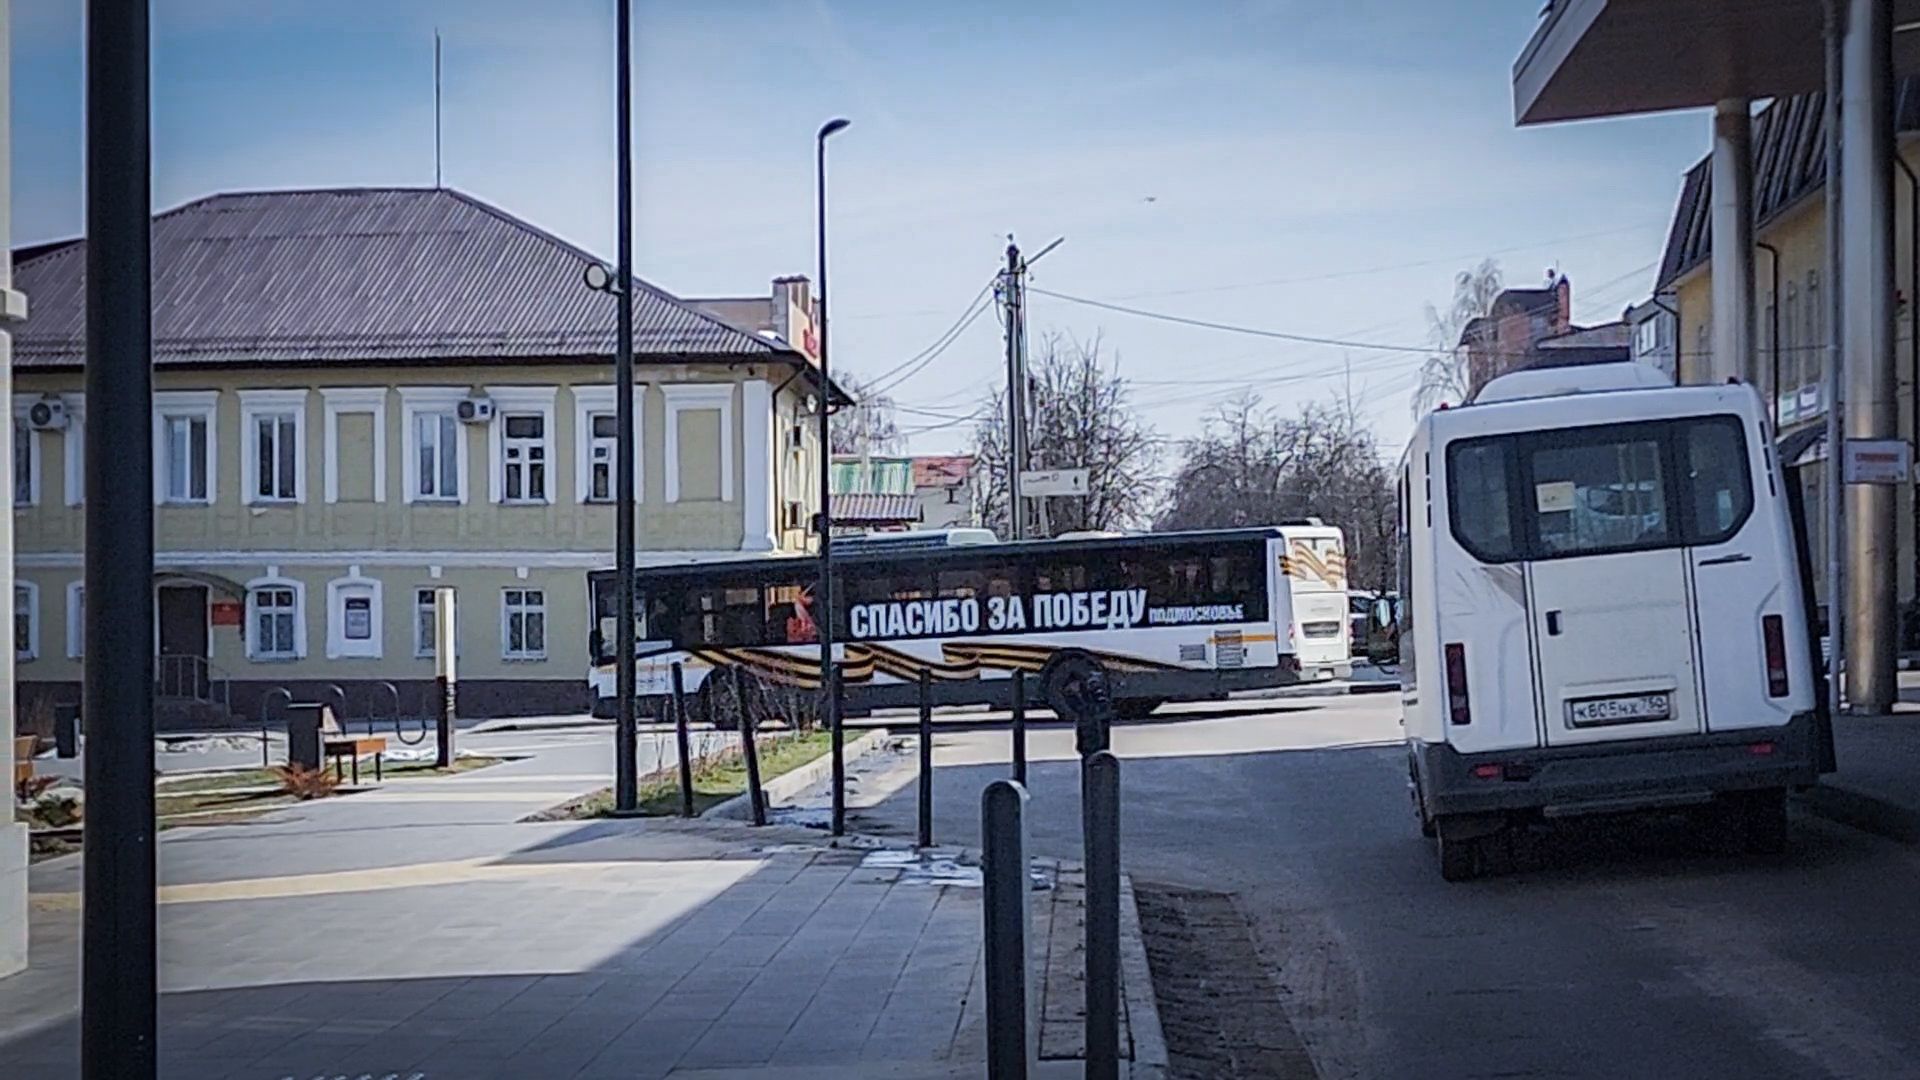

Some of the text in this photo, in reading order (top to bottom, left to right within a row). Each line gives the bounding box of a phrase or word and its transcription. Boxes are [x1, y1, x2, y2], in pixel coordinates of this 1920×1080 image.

[850, 588, 1147, 639] СПАСИБО ЗА ПОБЕДУ
